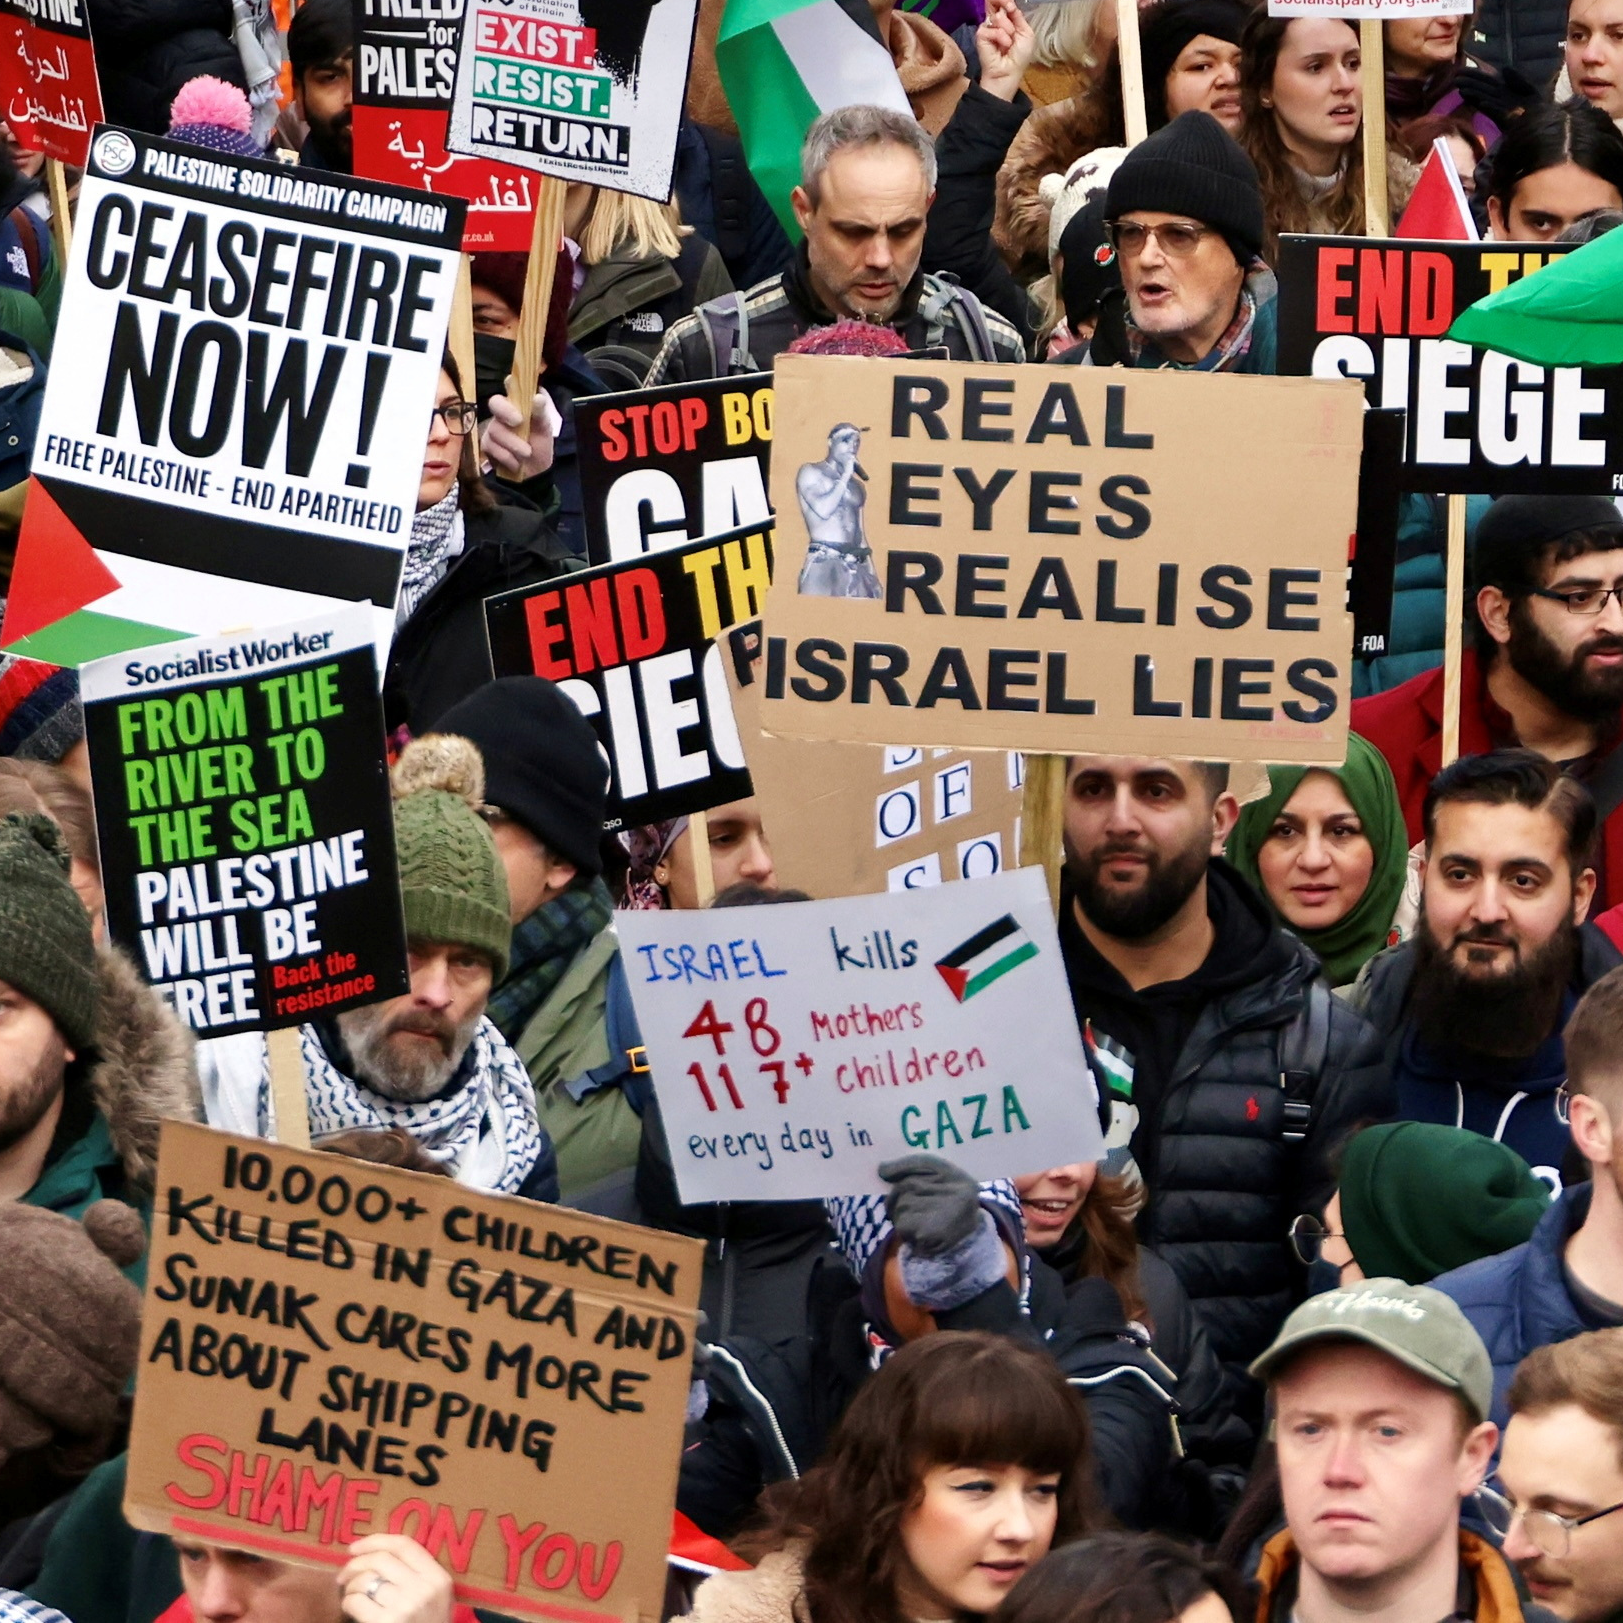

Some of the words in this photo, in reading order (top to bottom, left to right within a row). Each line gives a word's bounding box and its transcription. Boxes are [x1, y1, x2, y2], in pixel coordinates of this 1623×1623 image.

[476, 13, 595, 66] EXIST.
[474, 60, 609, 114] RESIST.
[473, 105, 628, 162] RETURN.
[891, 375, 1154, 449] REAL
[889, 462, 1152, 540] EYES
[885, 550, 1321, 632] REALISE
[765, 635, 1096, 716] ISRAEL
[1133, 654, 1339, 724] LIES
[638, 939, 787, 984] ISRAEL
[829, 926, 918, 972] kills
[682, 997, 781, 1056] 48
[836, 1046, 986, 1094] children
[689, 1124, 771, 1171] every
[781, 1121, 833, 1158] day
[848, 1122, 873, 1147] in
[901, 1084, 1032, 1150] GAZA
[221, 1146, 429, 1226] 10,000+
[443, 1208, 678, 1297] CHILDREN
[166, 1188, 357, 1271] KILLED
[374, 1246, 431, 1290] IN
[446, 1258, 577, 1338] GAZA
[595, 1306, 686, 1362] AND
[148, 1319, 310, 1401] ABOUT
[319, 1366, 557, 1473] SHIPPING
[336, 1300, 472, 1364] CARES
[487, 1340, 650, 1415] MORE
[257, 1408, 447, 1488] LANES
[164, 1433, 381, 1546] SHAME
[382, 1497, 484, 1575] ON
[494, 1513, 622, 1599] YOU
